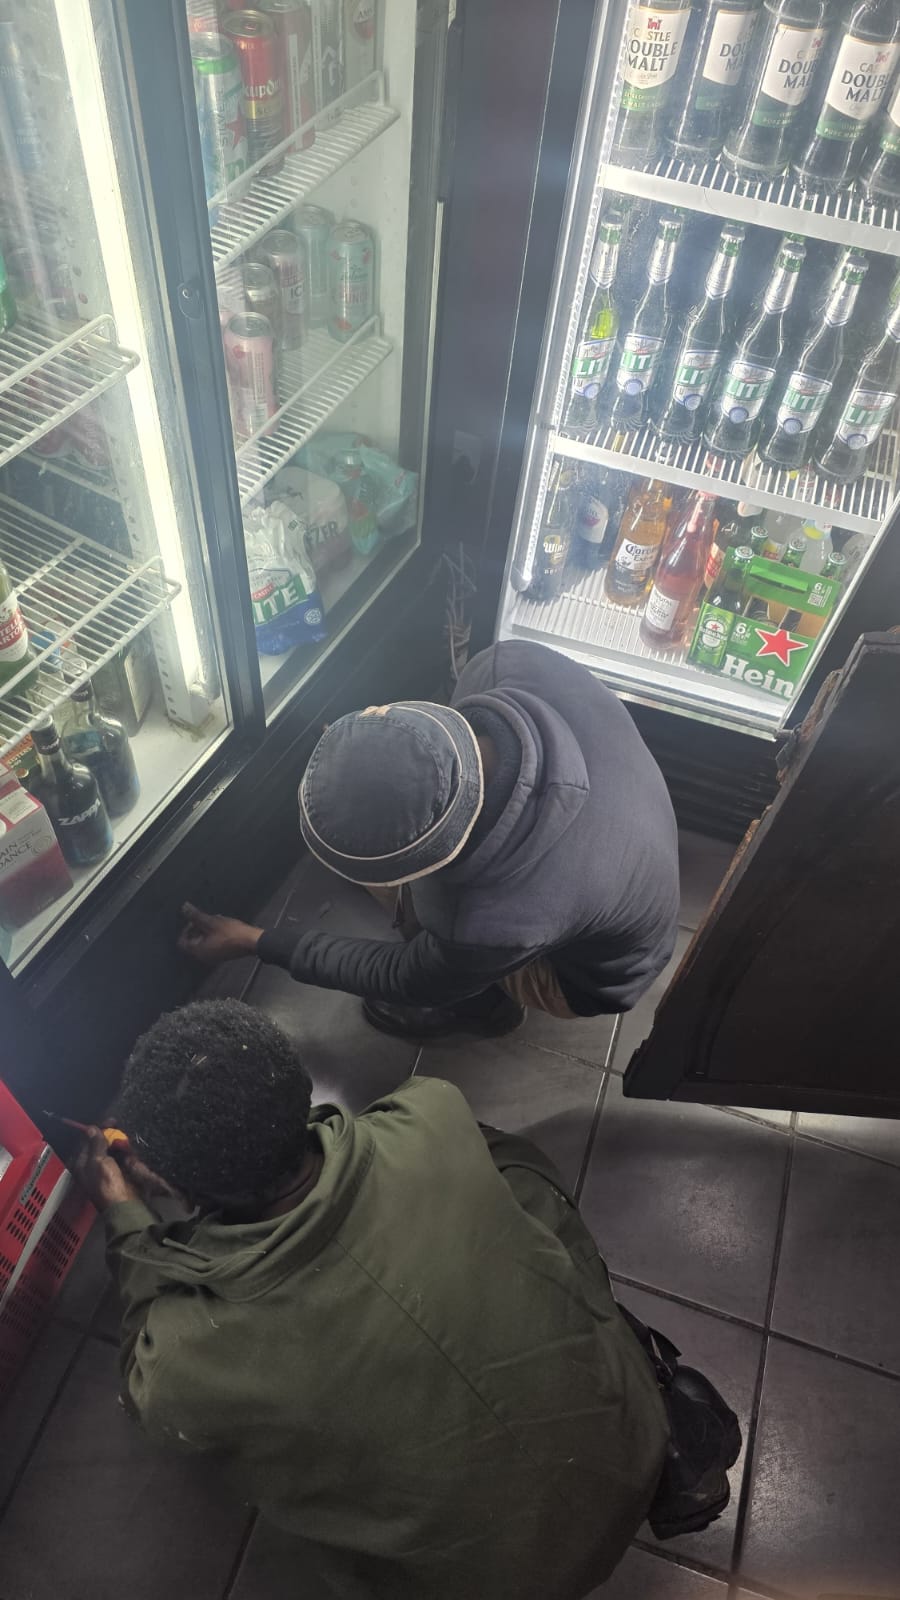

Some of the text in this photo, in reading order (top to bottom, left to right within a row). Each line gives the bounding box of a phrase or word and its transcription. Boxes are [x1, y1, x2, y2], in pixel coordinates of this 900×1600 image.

[633, 27, 671, 42] CSTLE
[629, 39, 678, 58] OUBLE
[254, 580, 300, 623] ITE
